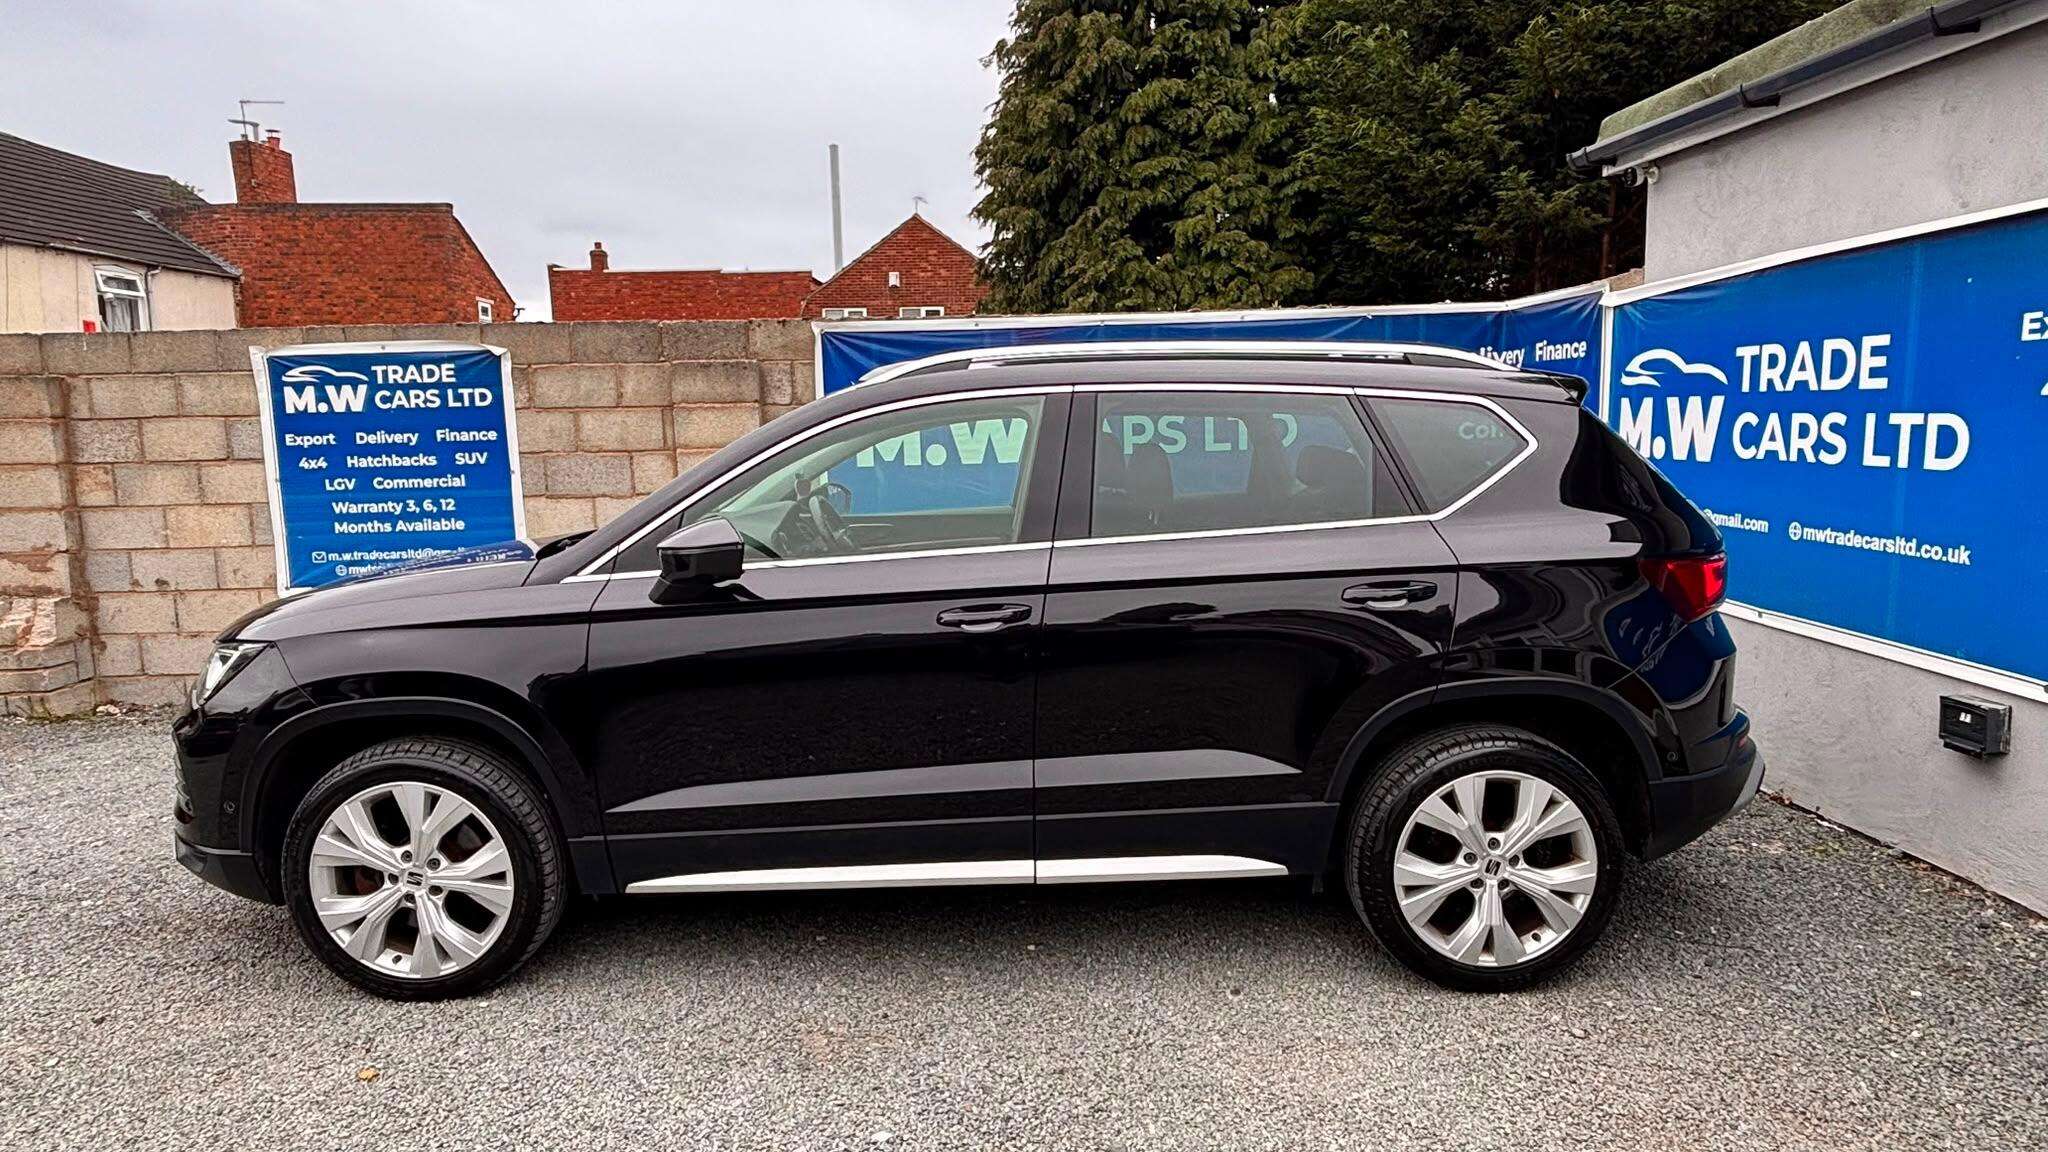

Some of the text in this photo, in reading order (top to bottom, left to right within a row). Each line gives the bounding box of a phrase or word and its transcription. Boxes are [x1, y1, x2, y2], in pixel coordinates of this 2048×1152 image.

[1535, 340, 1587, 362] Finance
[371, 364, 456, 385] TRADE
[1735, 334, 1891, 393] TRADE
[283, 384, 368, 414] M.W
[374, 388, 493, 410] CARS LTD
[285, 428, 498, 448] Export Delivery Finance
[1618, 395, 1725, 462] M.W
[857, 418, 1028, 467] M.W
[1732, 411, 1970, 472] CARS LTD
[298, 452, 488, 470] 4x4 Hatchbacks SUV
[325, 474, 466, 491] LGV Commercial
[332, 499, 456, 516] Warranty 3, 6, 12
[334, 518, 465, 534] Months Available
[1803, 525, 1971, 565] mwtradecarsltd.co.uk
